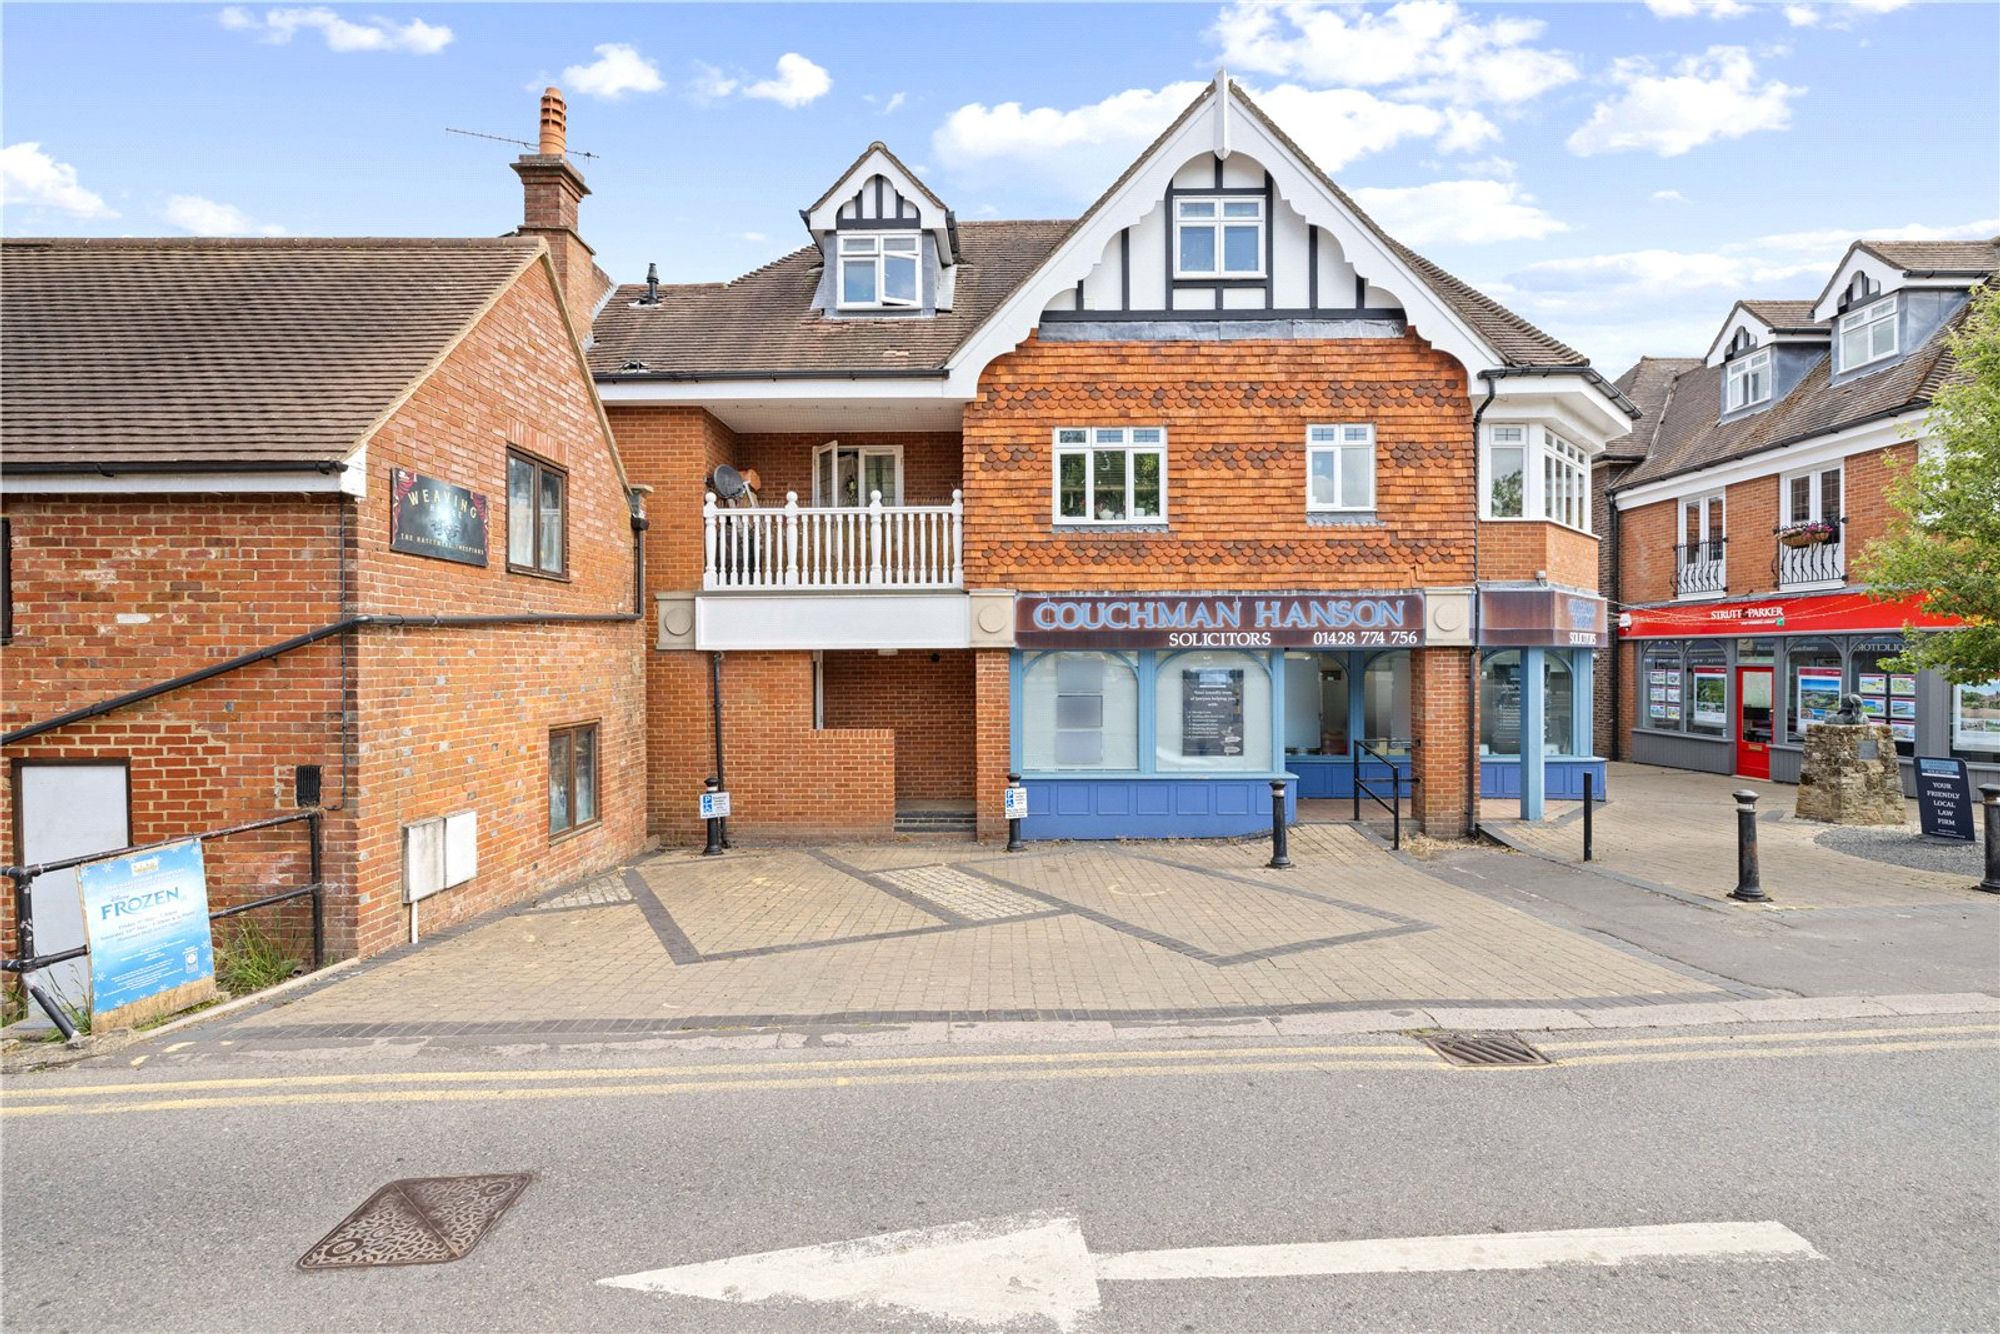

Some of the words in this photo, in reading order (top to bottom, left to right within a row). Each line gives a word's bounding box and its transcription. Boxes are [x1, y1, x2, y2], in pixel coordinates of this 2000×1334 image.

[408, 489, 477, 519] WEAVING
[1033, 601, 1242, 630] COUCHMAN
[1254, 600, 1405, 629] HANSON
[1711, 609, 1742, 620] STRUTT
[1748, 606, 1784, 618] PARKER
[1168, 632, 1271, 646] SOLICITORS
[1313, 631, 1356, 645] 01428
[1361, 631, 1385, 644] 774
[1390, 631, 1418, 645] 756
[1932, 782, 1952, 790] YOUR
[1926, 790, 1960, 799] FRIENDLY
[1933, 800, 1956, 809] LOCAL
[1937, 818, 1955, 826] FIRM
[100, 886, 179, 920] FROZEN
